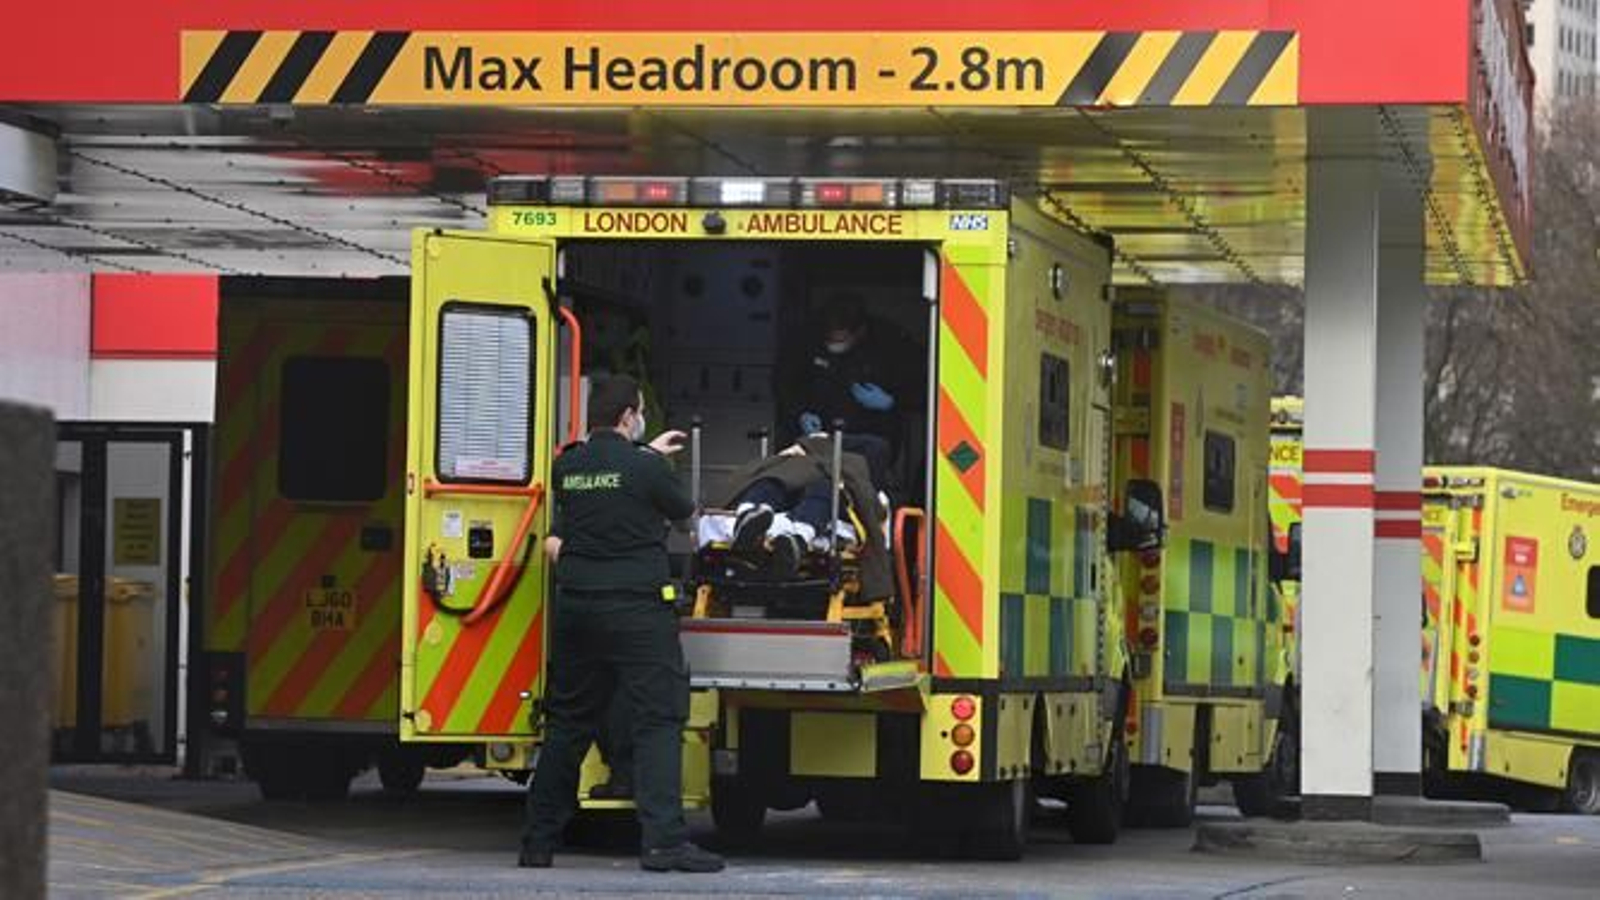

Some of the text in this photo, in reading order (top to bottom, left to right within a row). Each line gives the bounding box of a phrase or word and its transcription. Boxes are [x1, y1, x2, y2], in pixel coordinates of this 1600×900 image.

[423, 47, 541, 92] Max
[564, 45, 856, 92] Headroom
[909, 46, 1045, 92] 2.8m
[512, 211, 557, 226] 7693
[583, 212, 903, 234] LONDON AMBULANCE
[949, 214, 988, 230] NHS
[562, 473, 622, 491] AMBULANCE
